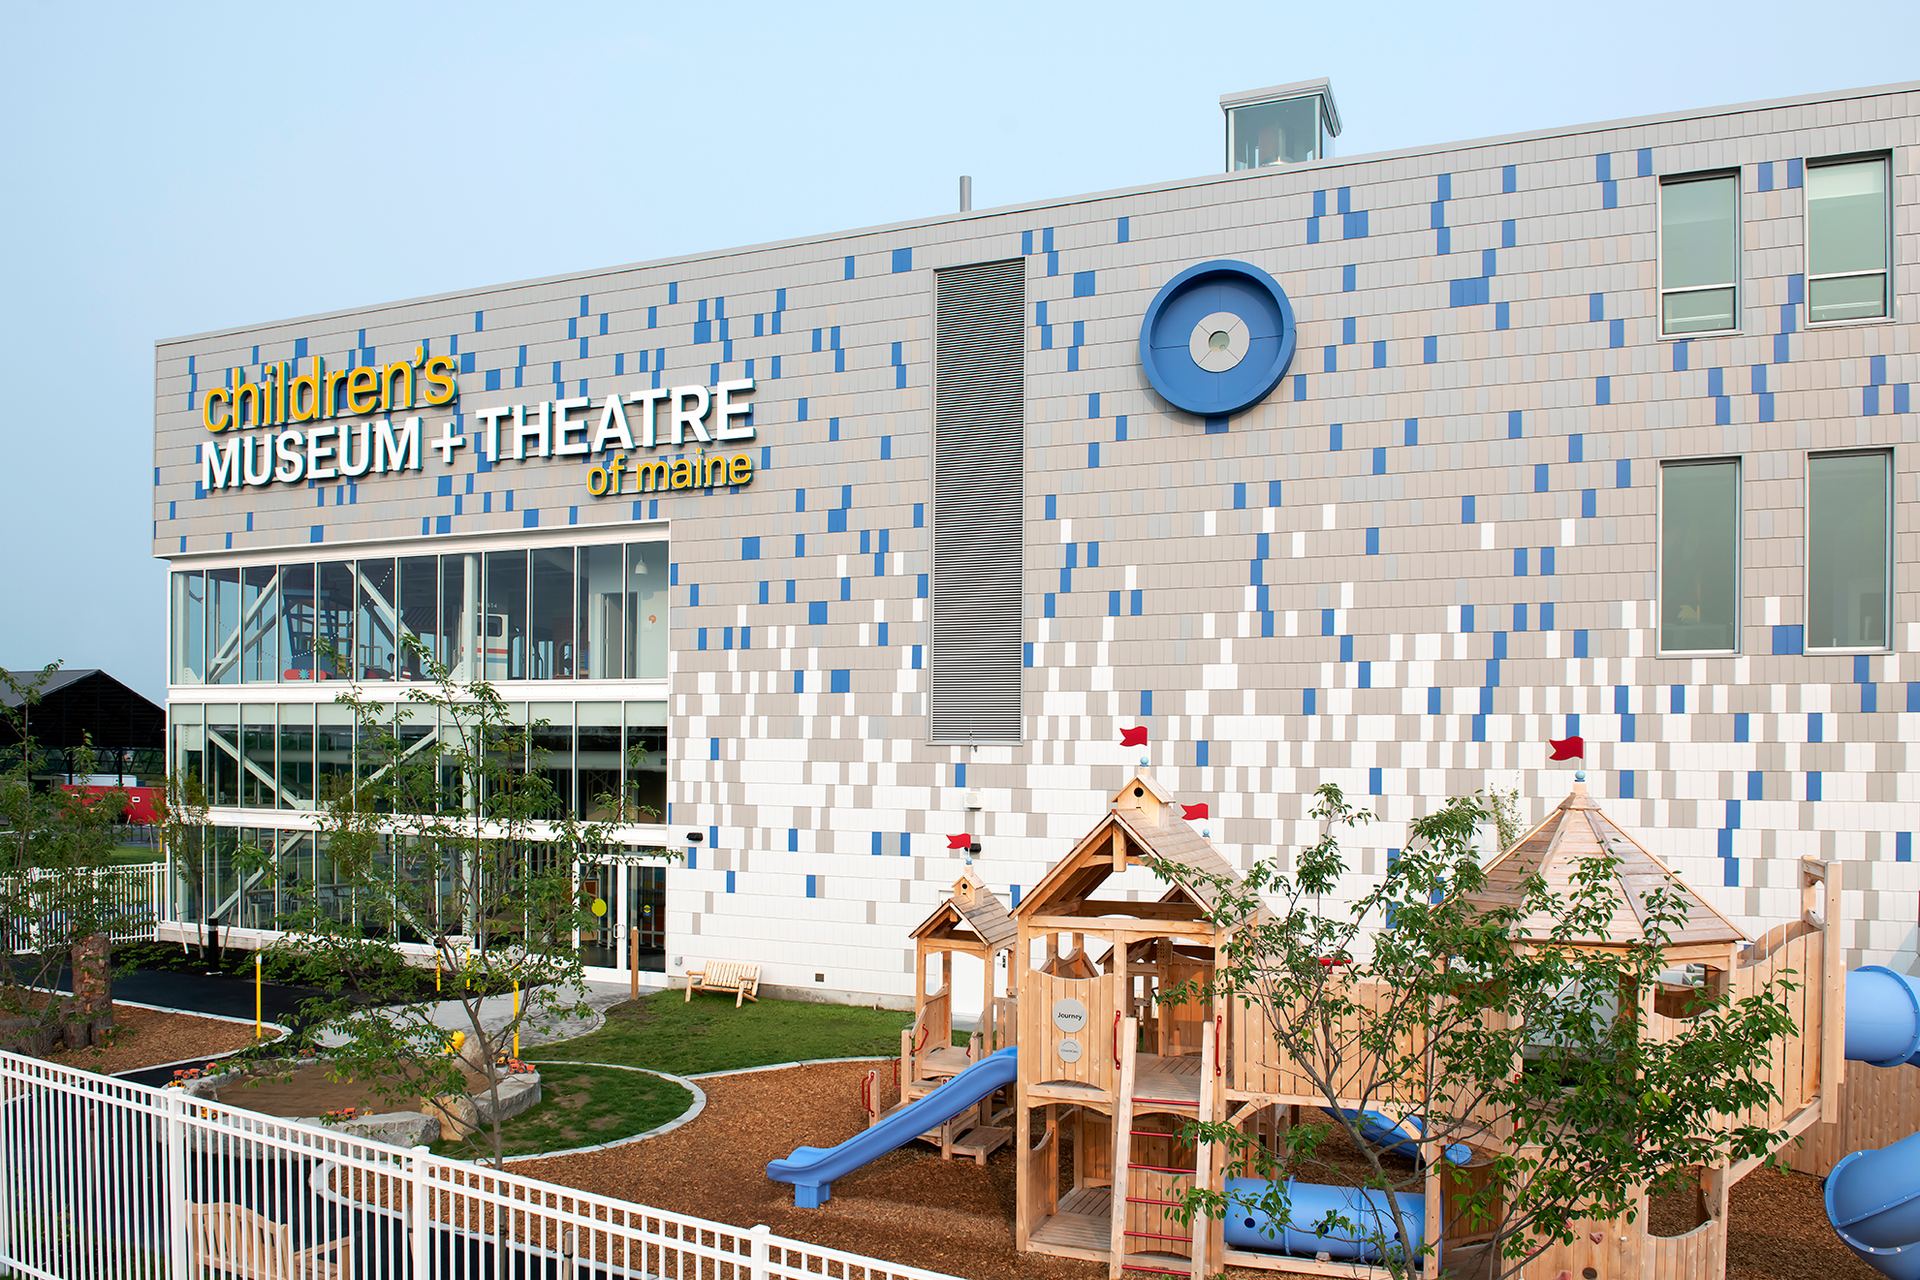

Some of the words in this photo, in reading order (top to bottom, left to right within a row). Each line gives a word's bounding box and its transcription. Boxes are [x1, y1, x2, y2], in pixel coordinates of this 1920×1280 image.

[203, 346, 458, 432] children's
[202, 416, 423, 490] MUSEUM
[476, 378, 756, 462] THEATRE
[586, 454, 627, 496] of
[636, 448, 753, 491] maine
[1057, 1012, 1082, 1021] Journey
